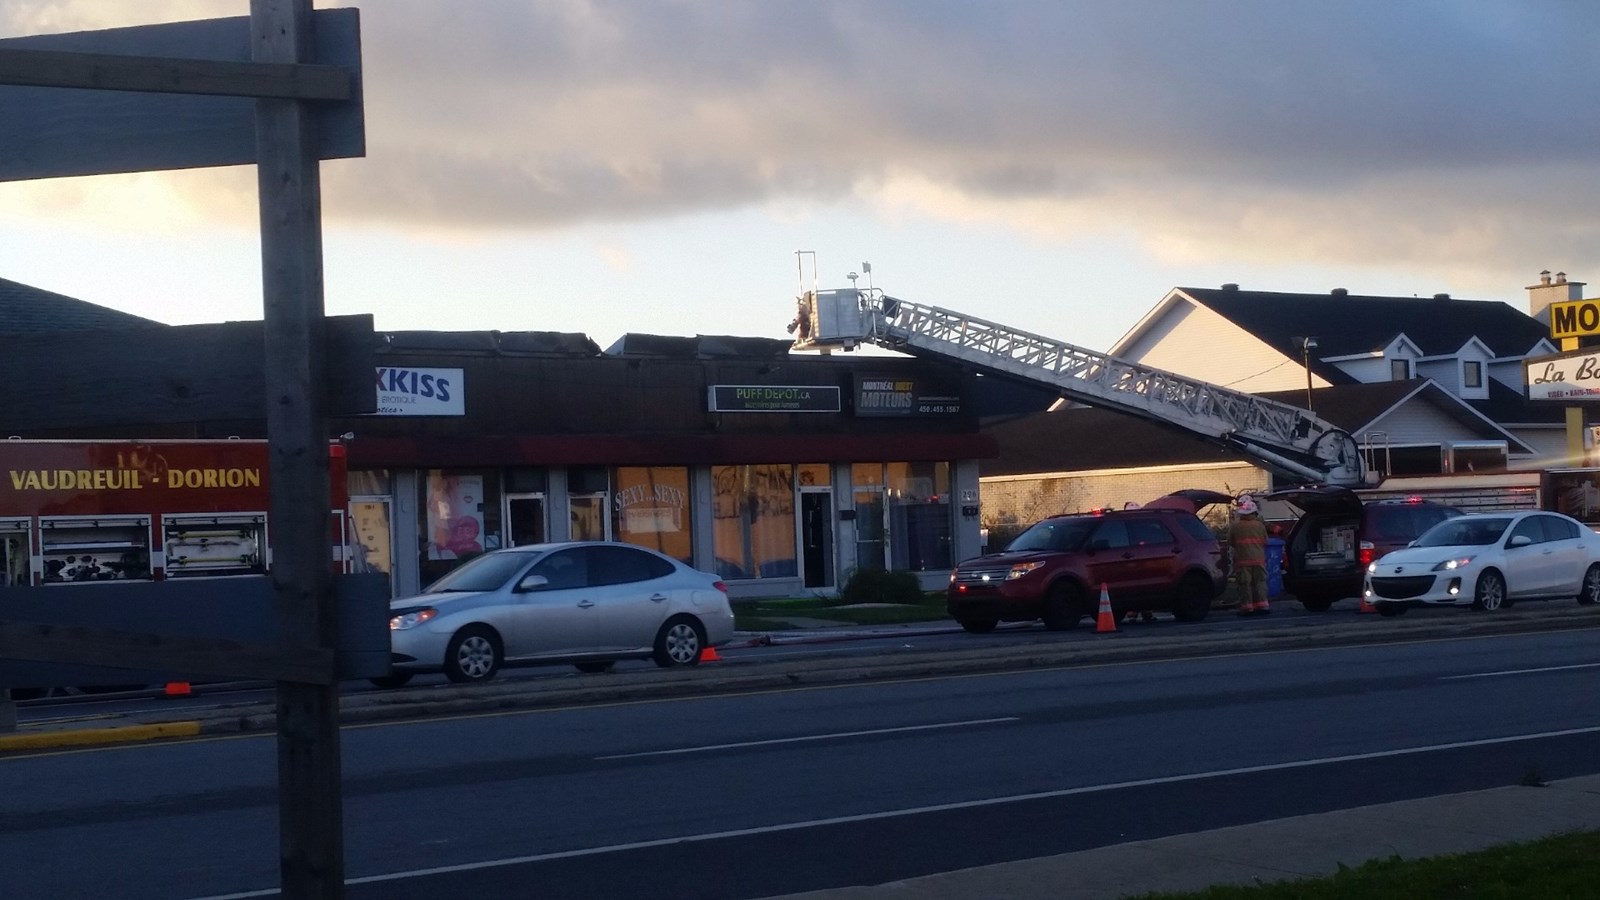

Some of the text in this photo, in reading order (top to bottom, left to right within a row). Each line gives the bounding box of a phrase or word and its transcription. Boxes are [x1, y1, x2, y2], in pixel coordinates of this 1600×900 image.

[1534, 362, 1566, 385] La
[736, 388, 762, 400] PUFF
[860, 392, 913, 408] MOTEURS
[9, 469, 143, 490] VAUDREUIL
[167, 468, 261, 489] DORION
